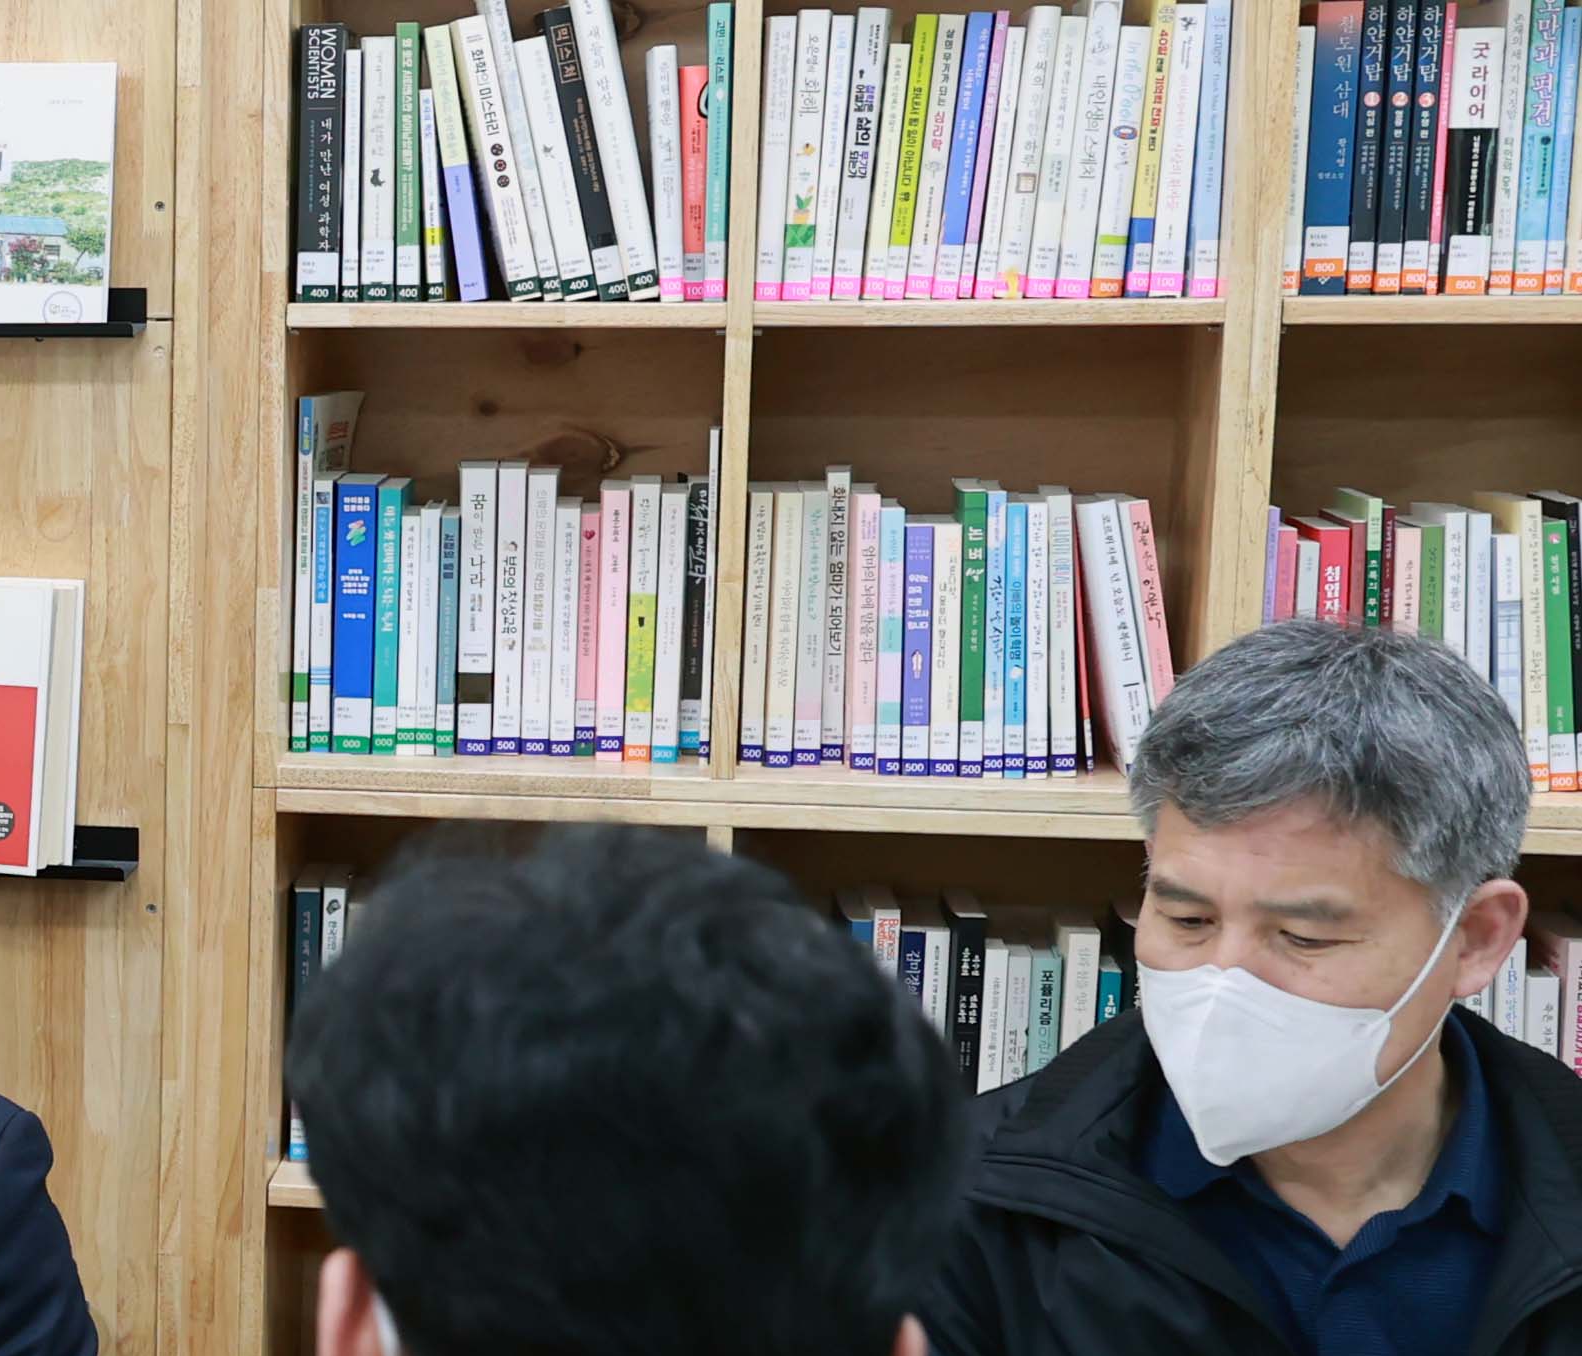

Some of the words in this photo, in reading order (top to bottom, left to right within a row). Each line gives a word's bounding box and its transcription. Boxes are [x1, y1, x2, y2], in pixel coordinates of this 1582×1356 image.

[1158, 29, 1169, 55] 40일
[1365, 5, 1386, 82] 하얀거탑
[1393, 5, 1415, 82] 하얀거탑
[1420, 5, 1442, 82] 하얀거탑
[307, 29, 320, 100] SCIENTISTS
[320, 28, 337, 99] WOMEN
[479, 87, 500, 137] 미스터리
[1333, 81, 1353, 119] 삼대
[1530, 72, 1553, 128] 편견
[320, 117, 333, 144] 내가
[856, 116, 871, 147] 삶의
[320, 149, 332, 177] 만난
[310, 288, 329, 298] 400
[367, 287, 386, 297] 400
[399, 288, 417, 298] 400
[516, 281, 534, 292] 400
[570, 280, 588, 290] 400
[608, 283, 626, 294] 400
[635, 275, 653, 286] 400
[830, 486, 845, 525] 화내지
[830, 530, 844, 555] 않는
[502, 555, 518, 588] 부모의
[830, 561, 844, 602] 엄마가
[501, 603, 517, 634] 성교육
[828, 604, 842, 656] 되어보기
[1010, 639, 1021, 660] 혁명
[467, 743, 485, 752] 500
[497, 741, 515, 750] 500
[526, 742, 544, 752] 500
[577, 730, 594, 740] 500
[601, 740, 619, 749] 500
[552, 744, 570, 754] 500
[743, 748, 762, 758] 500
[769, 755, 788, 764] 500
[796, 753, 814, 762] 500
